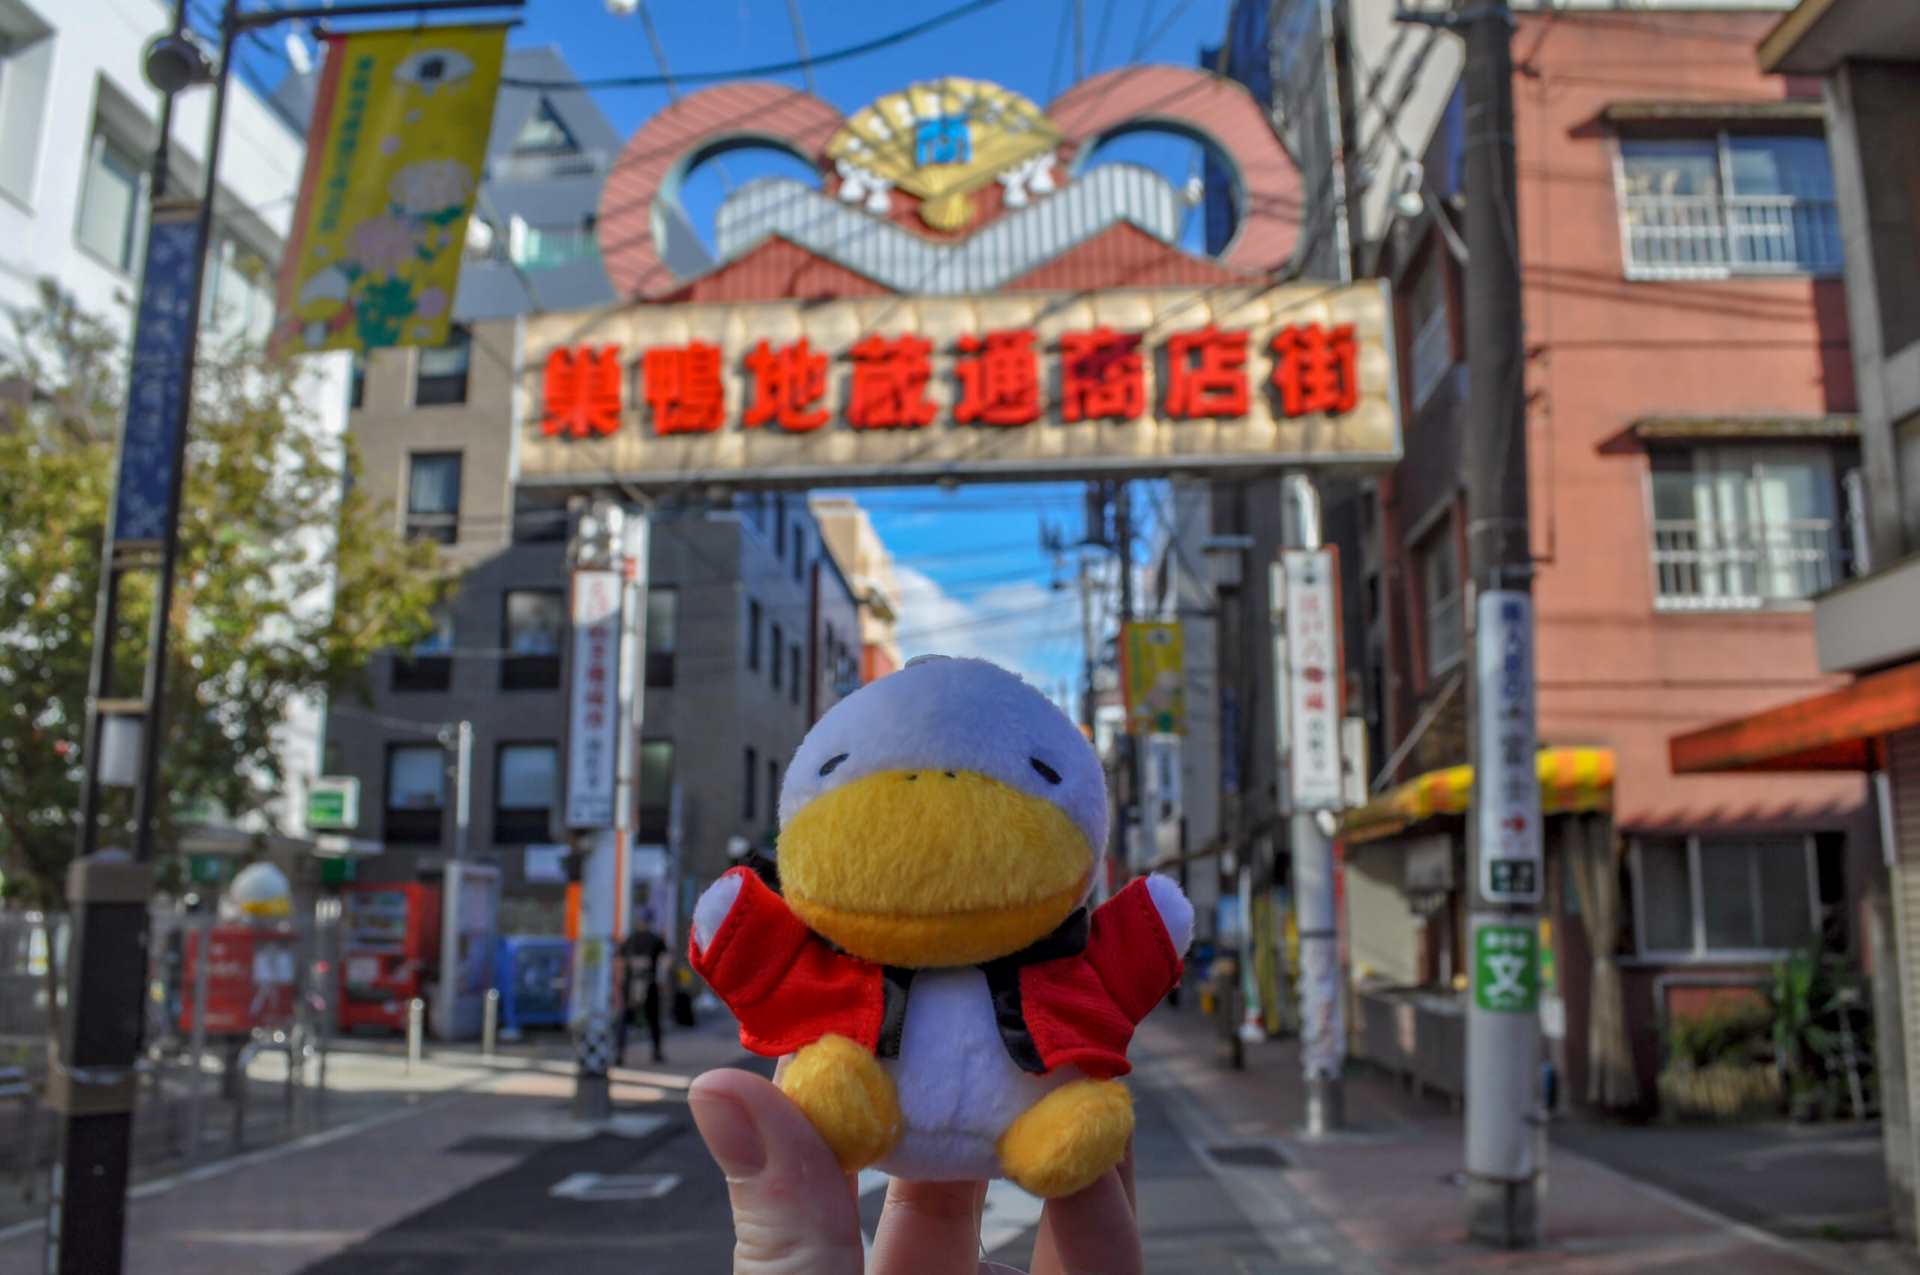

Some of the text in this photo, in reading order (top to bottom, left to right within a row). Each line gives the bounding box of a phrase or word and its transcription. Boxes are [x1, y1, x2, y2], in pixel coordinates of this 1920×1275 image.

[541, 322, 1358, 438] 巣鴨地蔵通商店街
